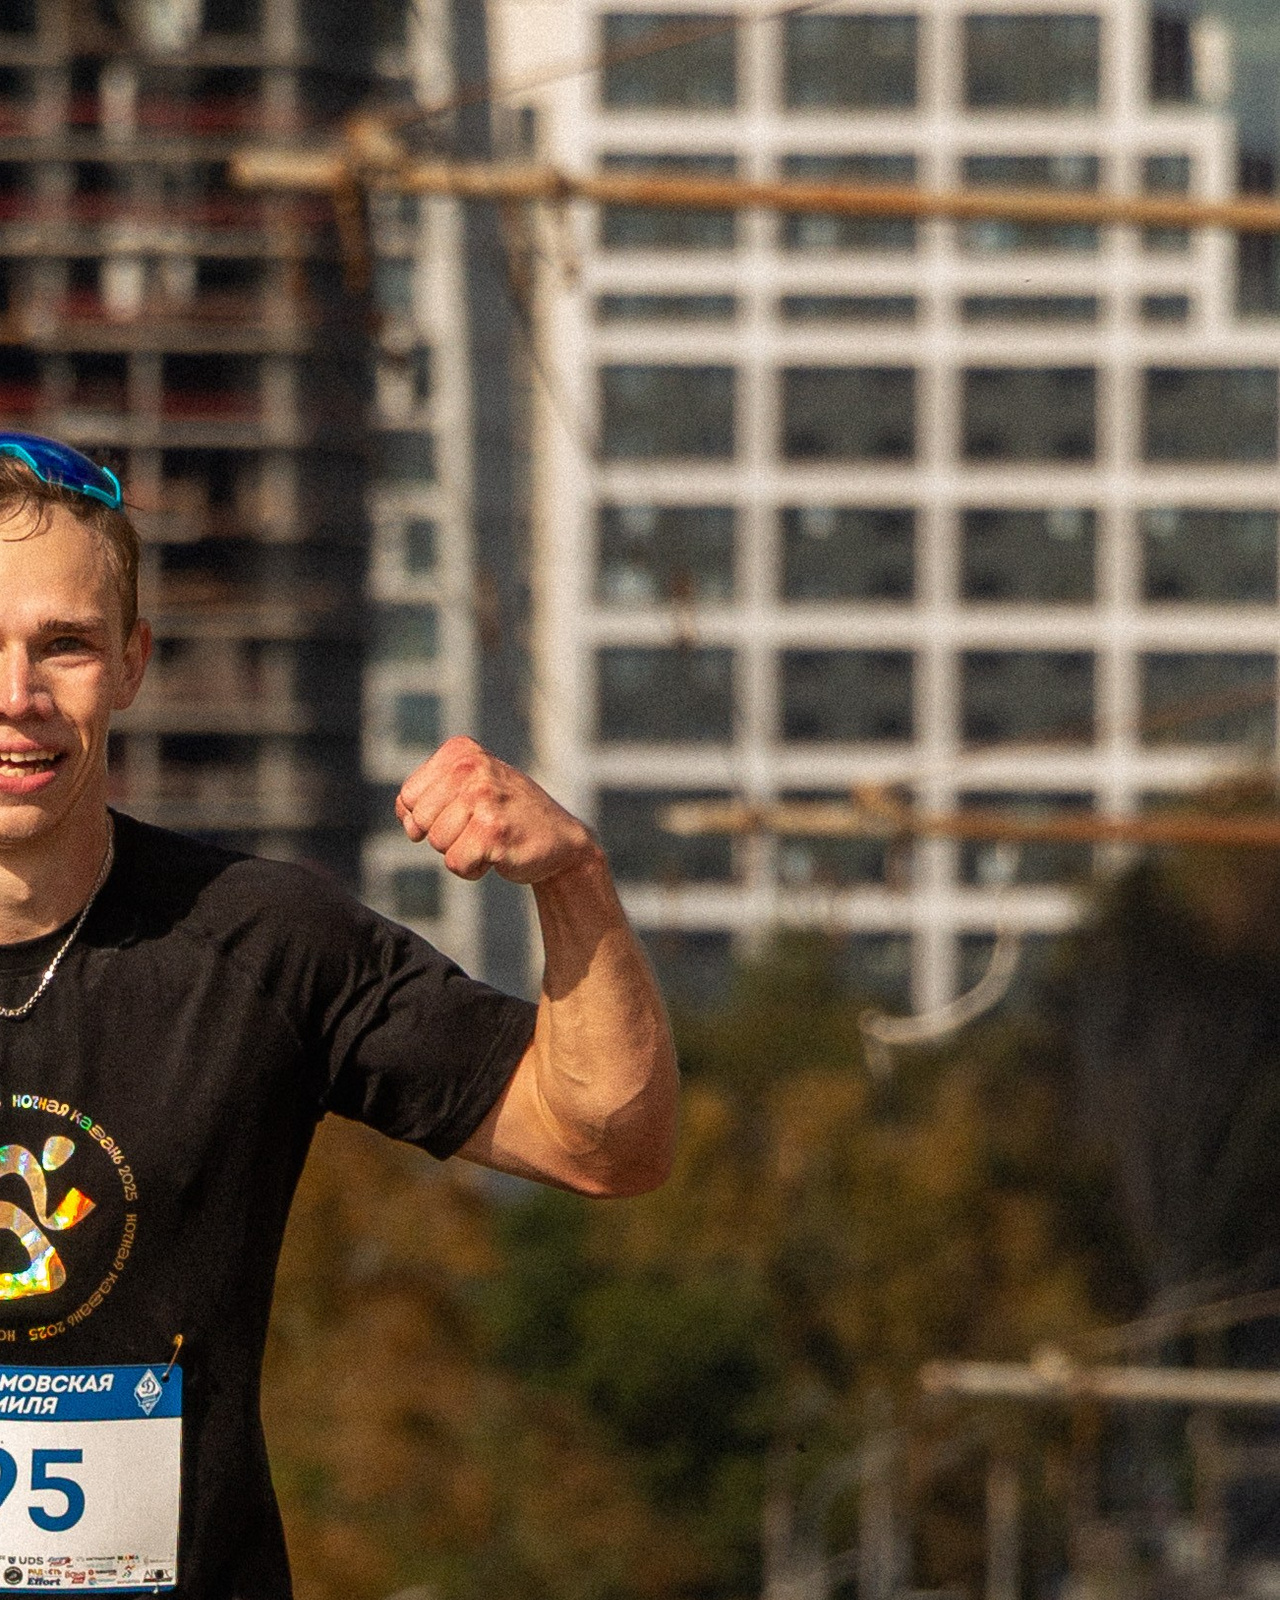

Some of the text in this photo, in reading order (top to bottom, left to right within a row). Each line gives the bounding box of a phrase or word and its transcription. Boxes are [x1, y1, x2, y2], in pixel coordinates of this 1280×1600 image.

[117, 1165, 139, 1202] 2025
[28, 1321, 66, 1342] 2025
[19, 1556, 44, 1565] UDS
[27, 1577, 61, 1586] Effort
